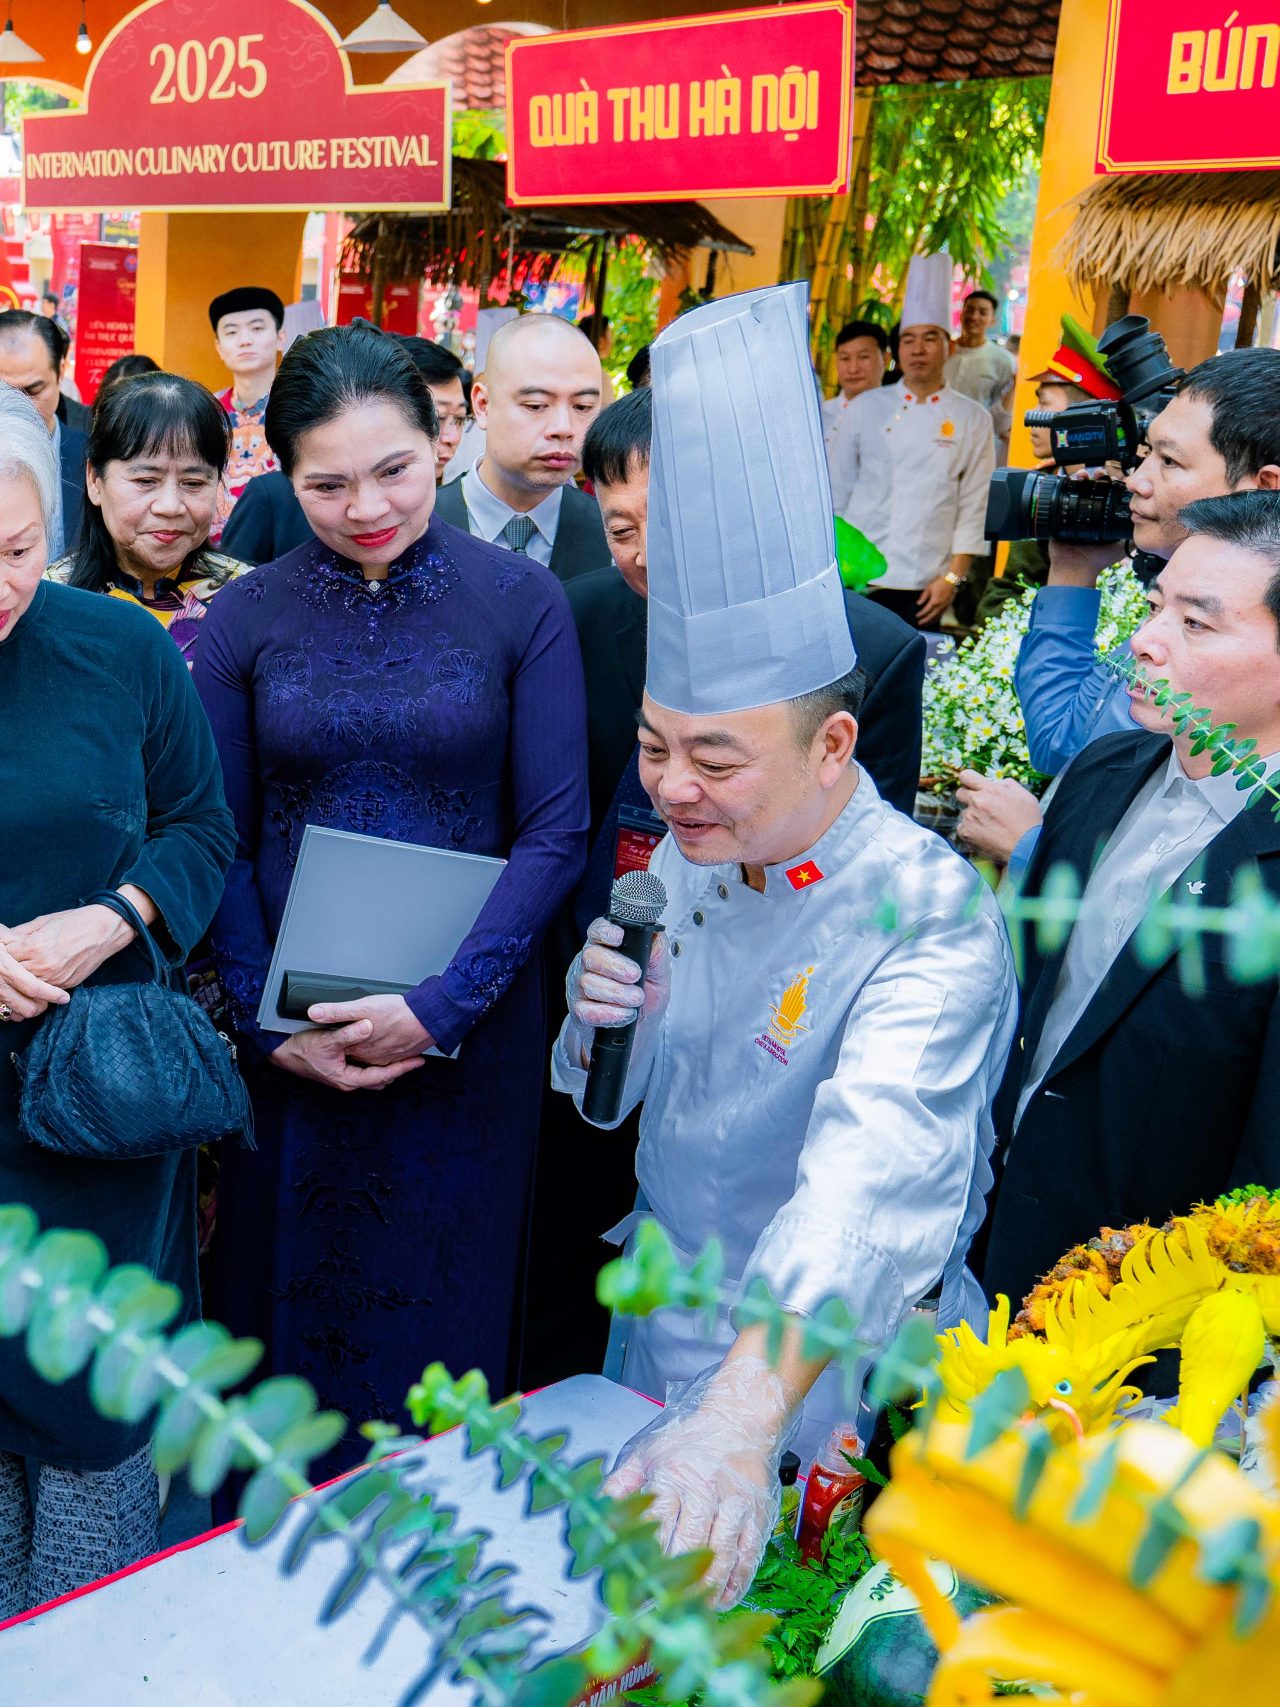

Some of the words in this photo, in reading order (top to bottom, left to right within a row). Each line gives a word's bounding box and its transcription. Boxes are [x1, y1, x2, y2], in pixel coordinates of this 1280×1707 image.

[149, 34, 268, 104] 2025
[1166, 10, 1280, 95] BÚN
[529, 77, 599, 148] QUÀ
[607, 83, 680, 143] THU
[689, 64, 741, 138] HÀ
[751, 65, 820, 142] NỘI
[26, 148, 134, 180] INTERNATION
[134, 144, 231, 177] CULINARY
[231, 138, 327, 173] CULTURE
[330, 134, 439, 170] FESTIVAL
